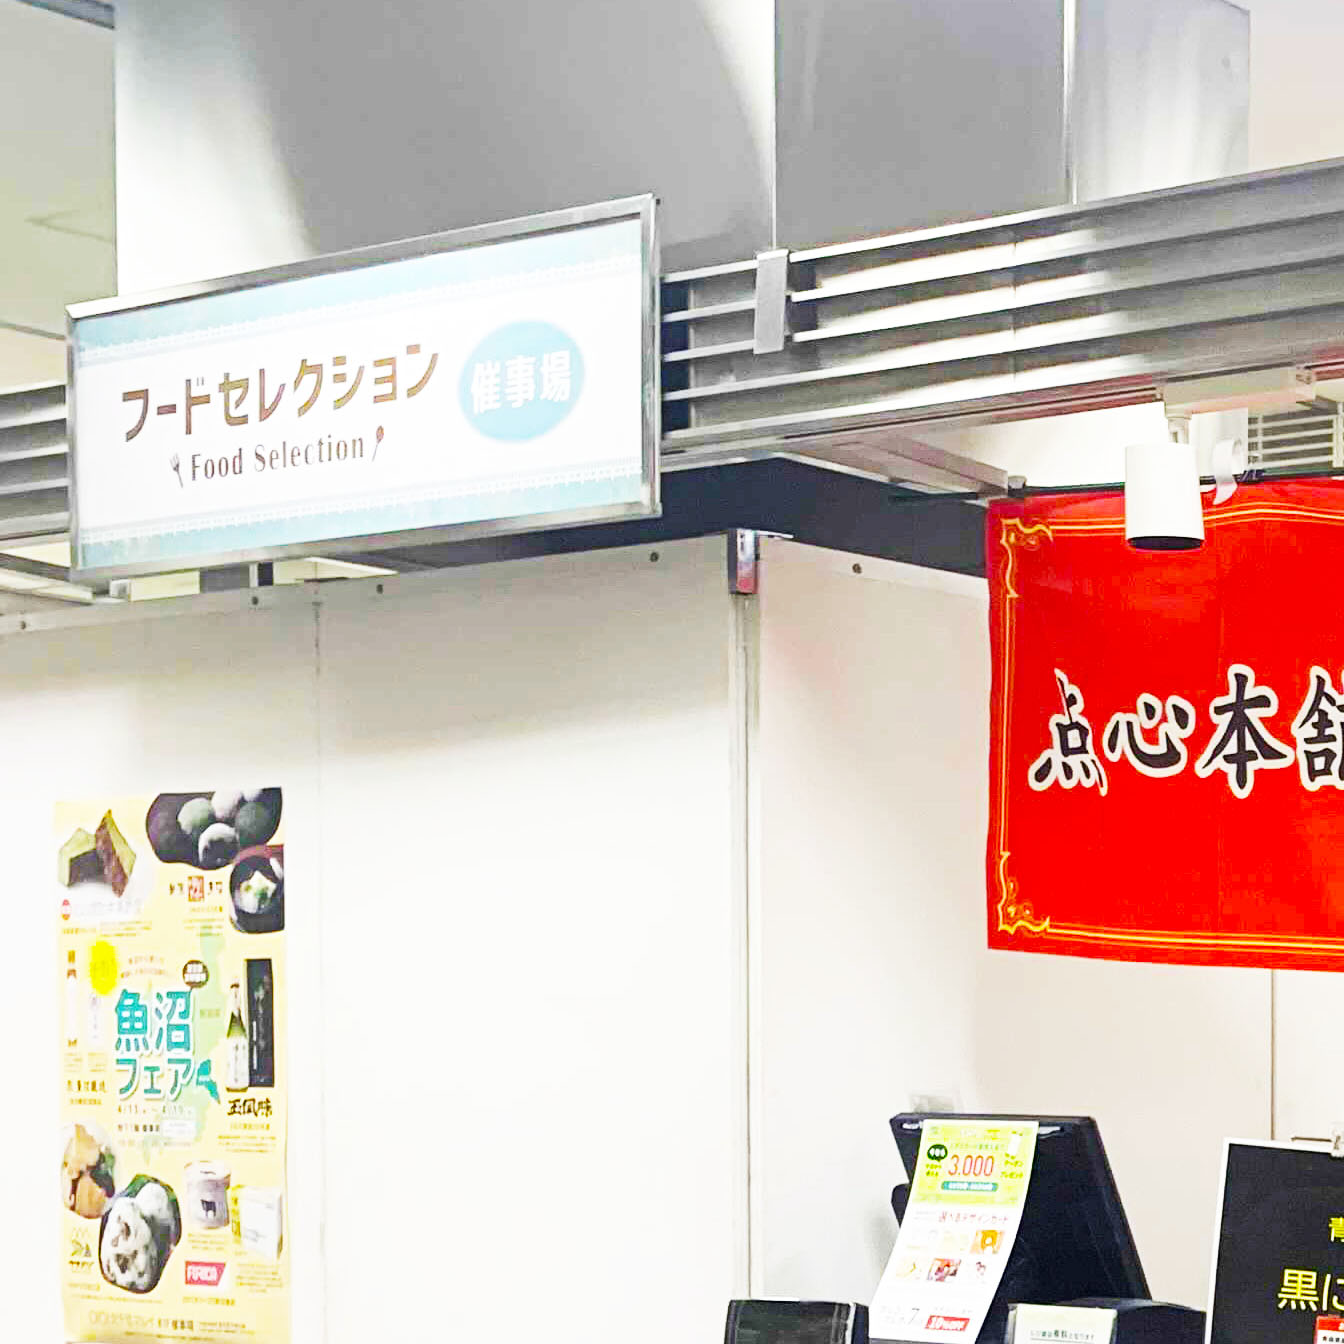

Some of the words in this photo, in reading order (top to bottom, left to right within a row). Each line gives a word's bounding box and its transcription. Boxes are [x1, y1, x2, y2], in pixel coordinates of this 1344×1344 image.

[121, 343, 439, 441] フードセレクション
[470, 349, 572, 416] 催事場
[191, 445, 243, 482] Food
[254, 437, 365, 472] Selection
[115, 989, 191, 1052] 魚沼
[115, 1058, 192, 1096] フェア
